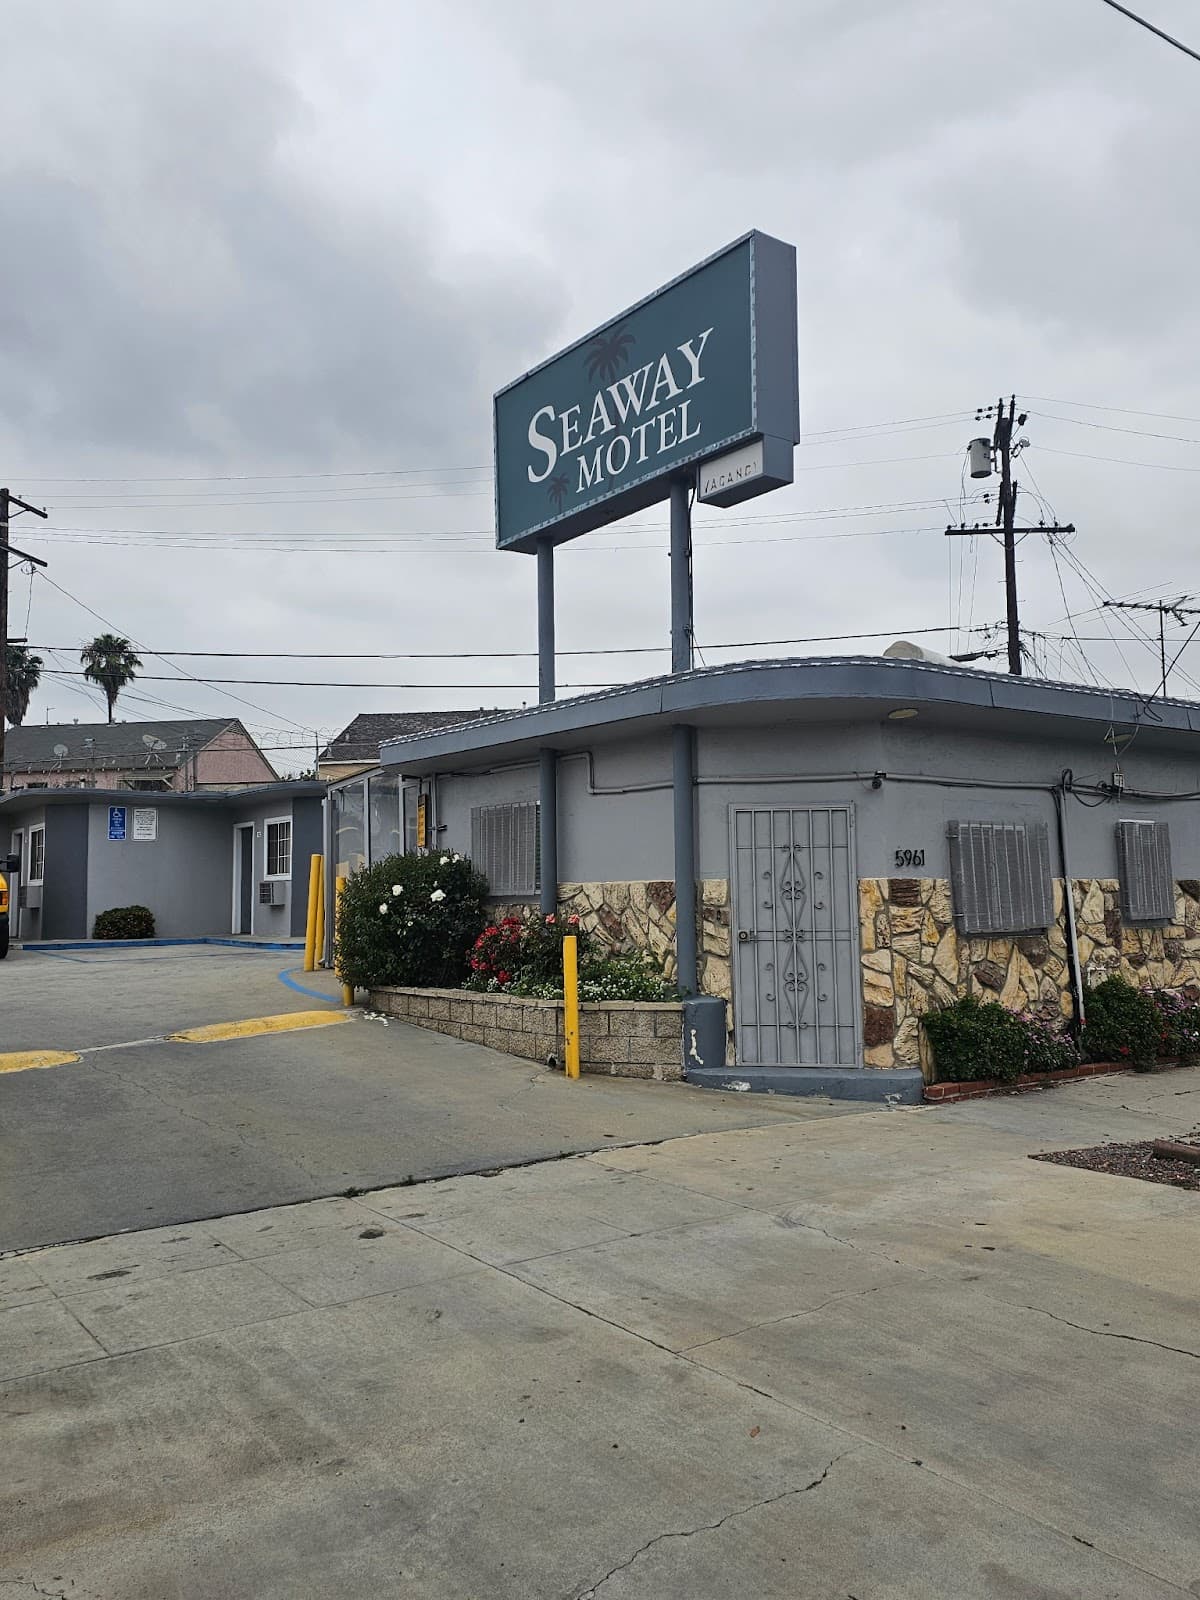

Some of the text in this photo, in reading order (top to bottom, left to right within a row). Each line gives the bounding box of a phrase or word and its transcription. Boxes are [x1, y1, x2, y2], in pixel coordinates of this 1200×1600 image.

[527, 327, 714, 483] SEAWAY
[575, 399, 701, 493] MOTEL
[895, 849, 925, 867] 5961
